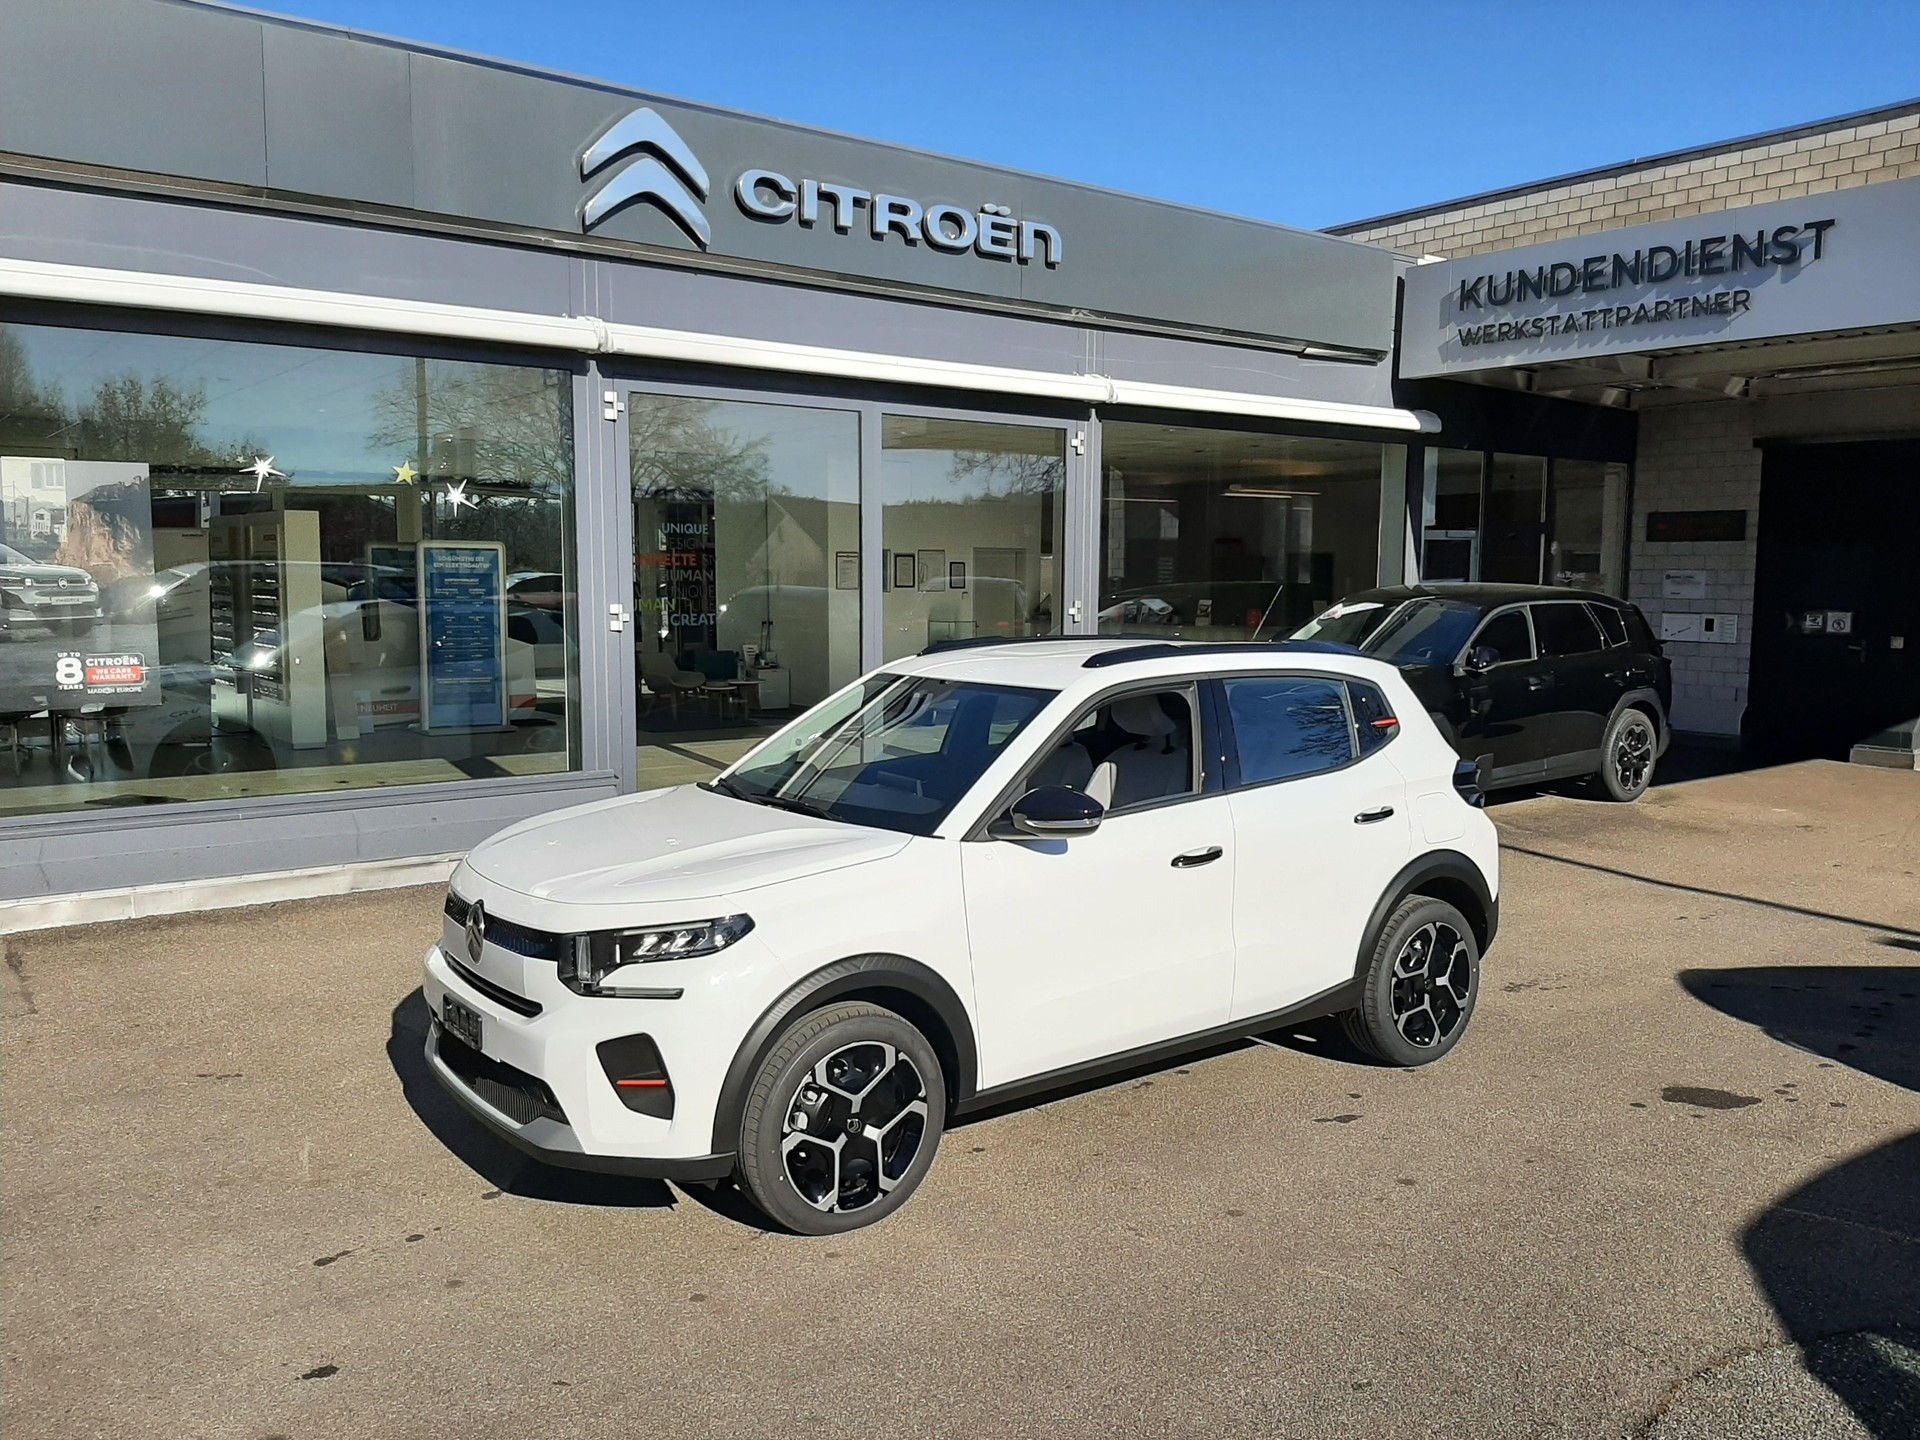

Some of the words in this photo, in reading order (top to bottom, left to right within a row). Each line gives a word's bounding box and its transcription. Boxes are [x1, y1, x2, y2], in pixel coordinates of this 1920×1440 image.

[735, 168, 1062, 269] CITROËN
[1458, 218, 1837, 312] KUNDENDIENST
[1457, 288, 1752, 347] WERKSTATTPARTNER
[661, 522, 709, 535] UNIQUE
[55, 657, 84, 684] 8
